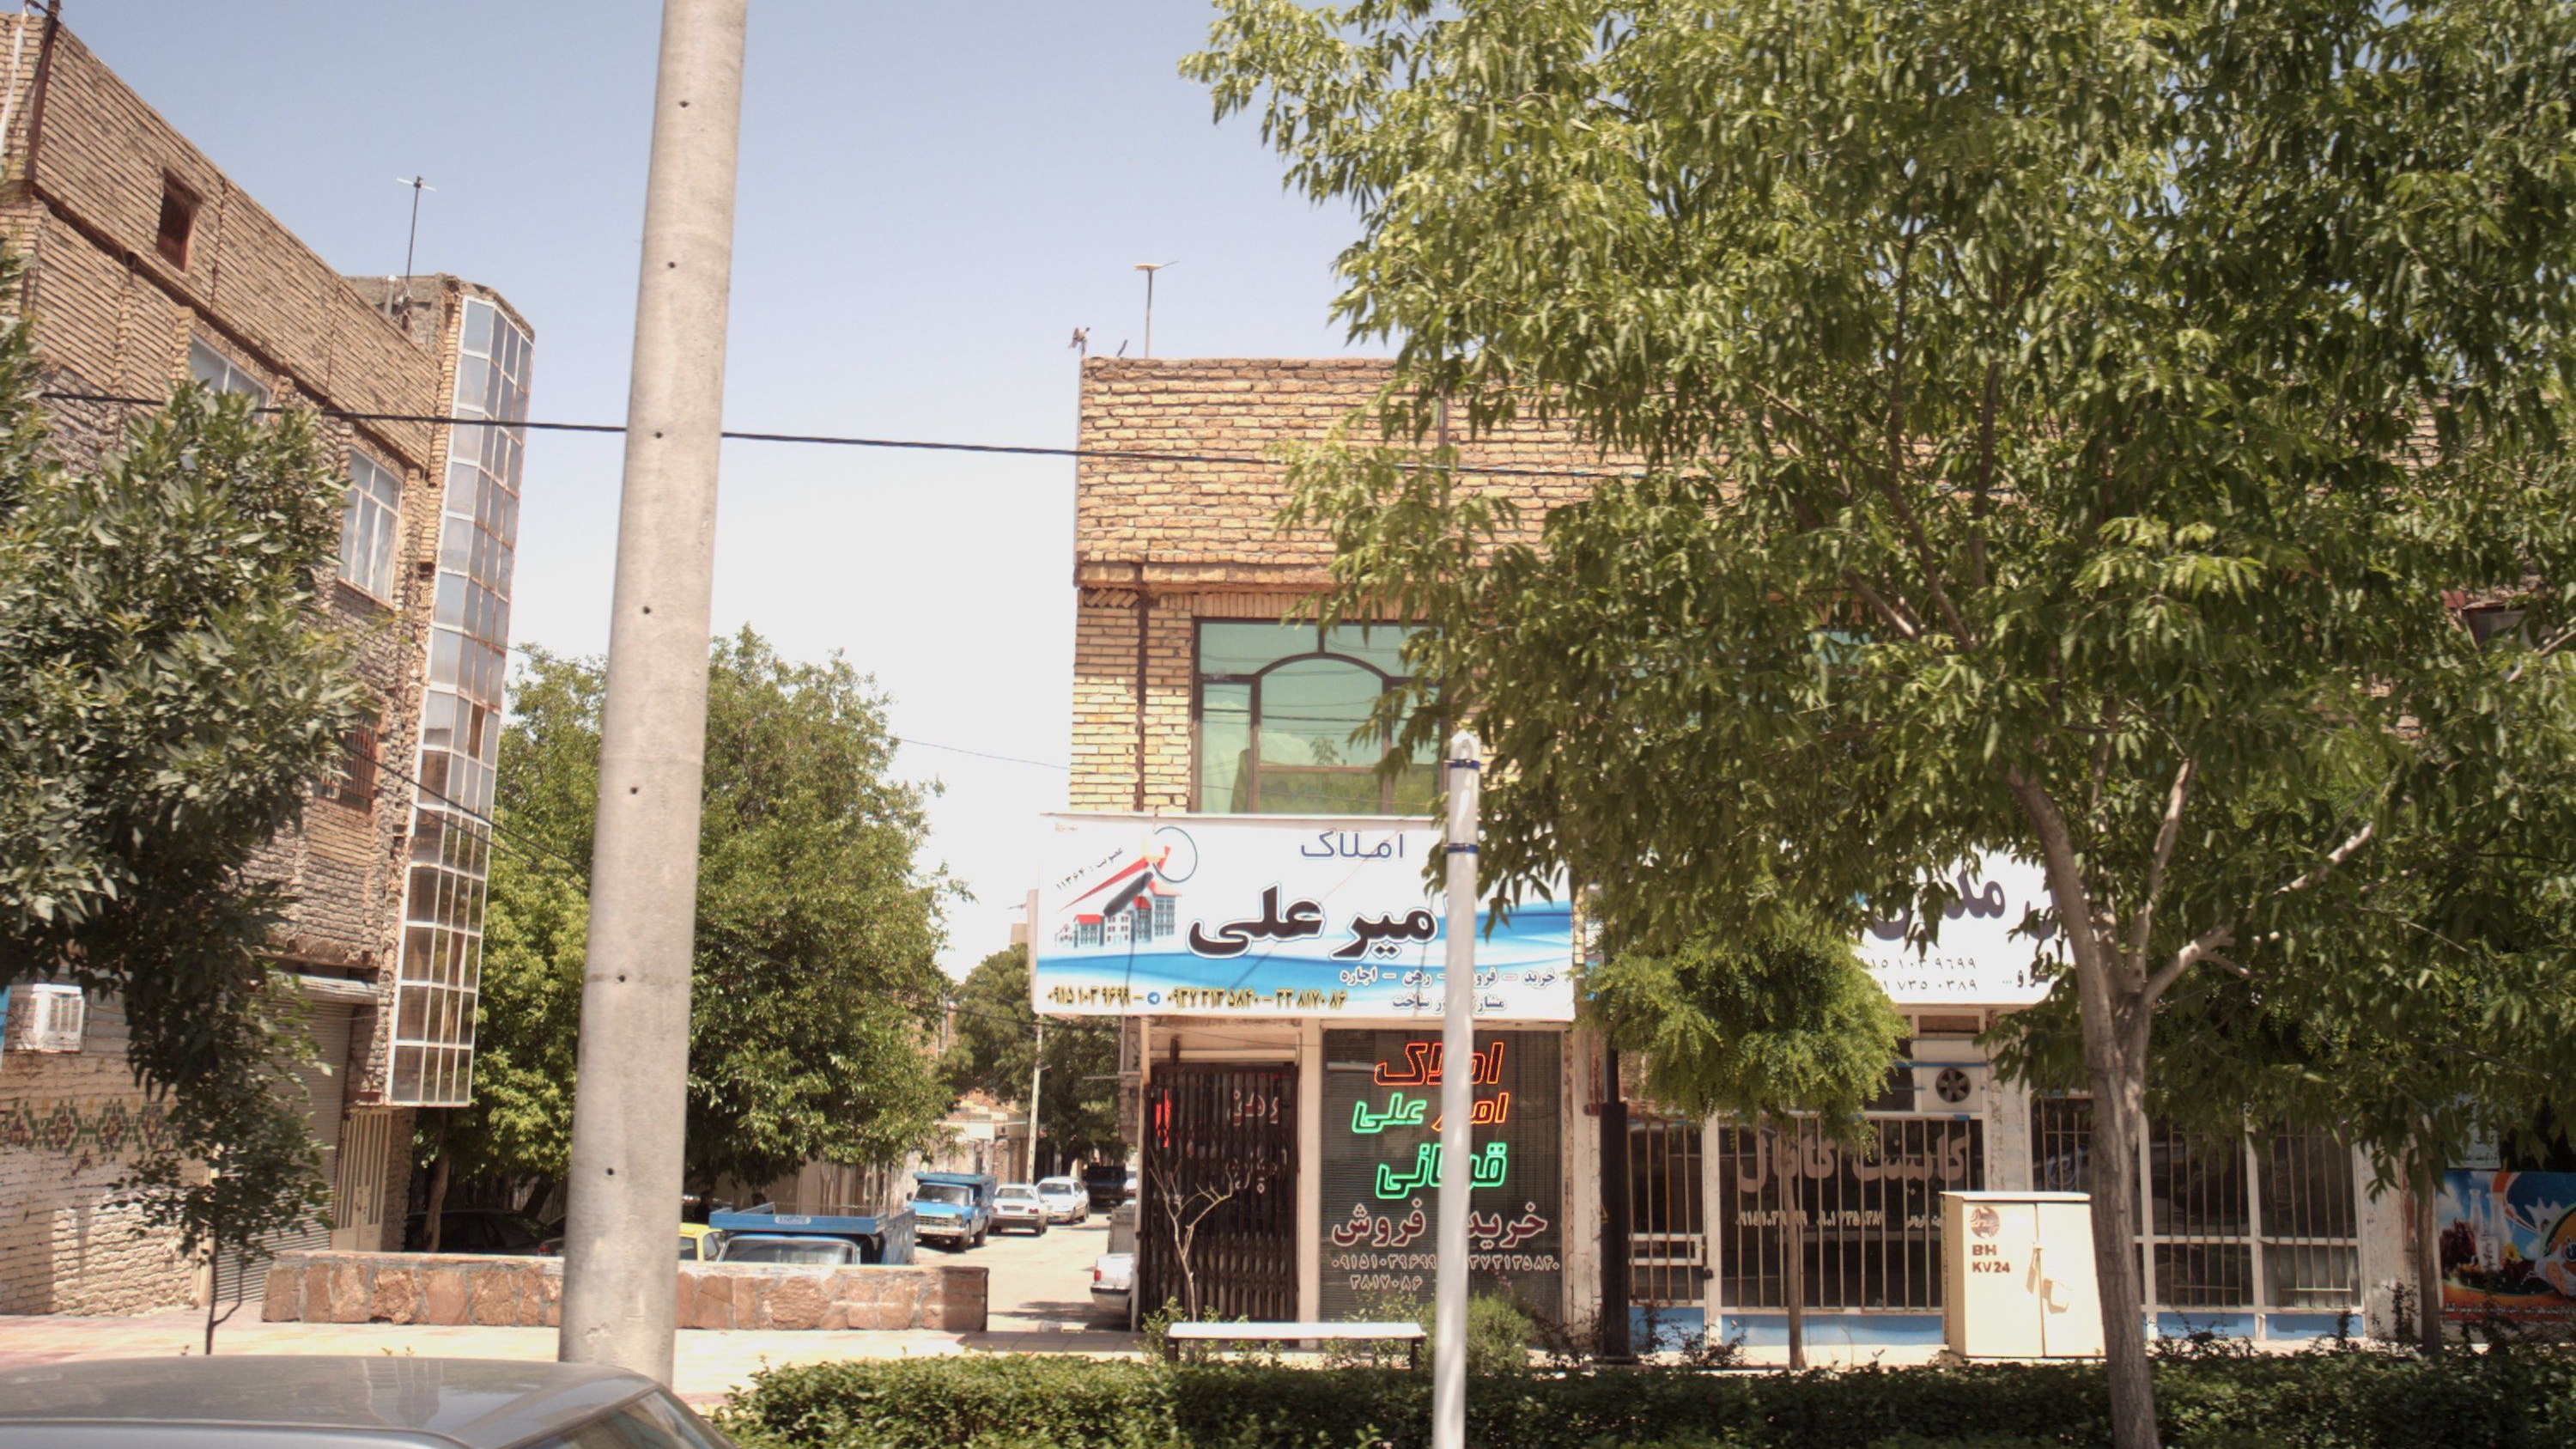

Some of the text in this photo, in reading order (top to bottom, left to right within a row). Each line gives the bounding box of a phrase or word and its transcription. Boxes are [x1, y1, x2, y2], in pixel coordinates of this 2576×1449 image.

[1300, 831, 1405, 859] املاک
[1188, 884, 1446, 959] میر علی
[1340, 967, 1378, 986] اجاره
[1404, 970, 1433, 986] رهن
[1524, 968, 1557, 986] خرید
[1392, 992, 1431, 1010] ساخت
[1352, 1092, 1428, 1134] علی
[1332, 1197, 1548, 1251] خرید فروش
[1971, 1245, 1997, 1256] BH
[1468, 1254, 1560, 1271] ۳۷۳۱۳۵۸۴۰
